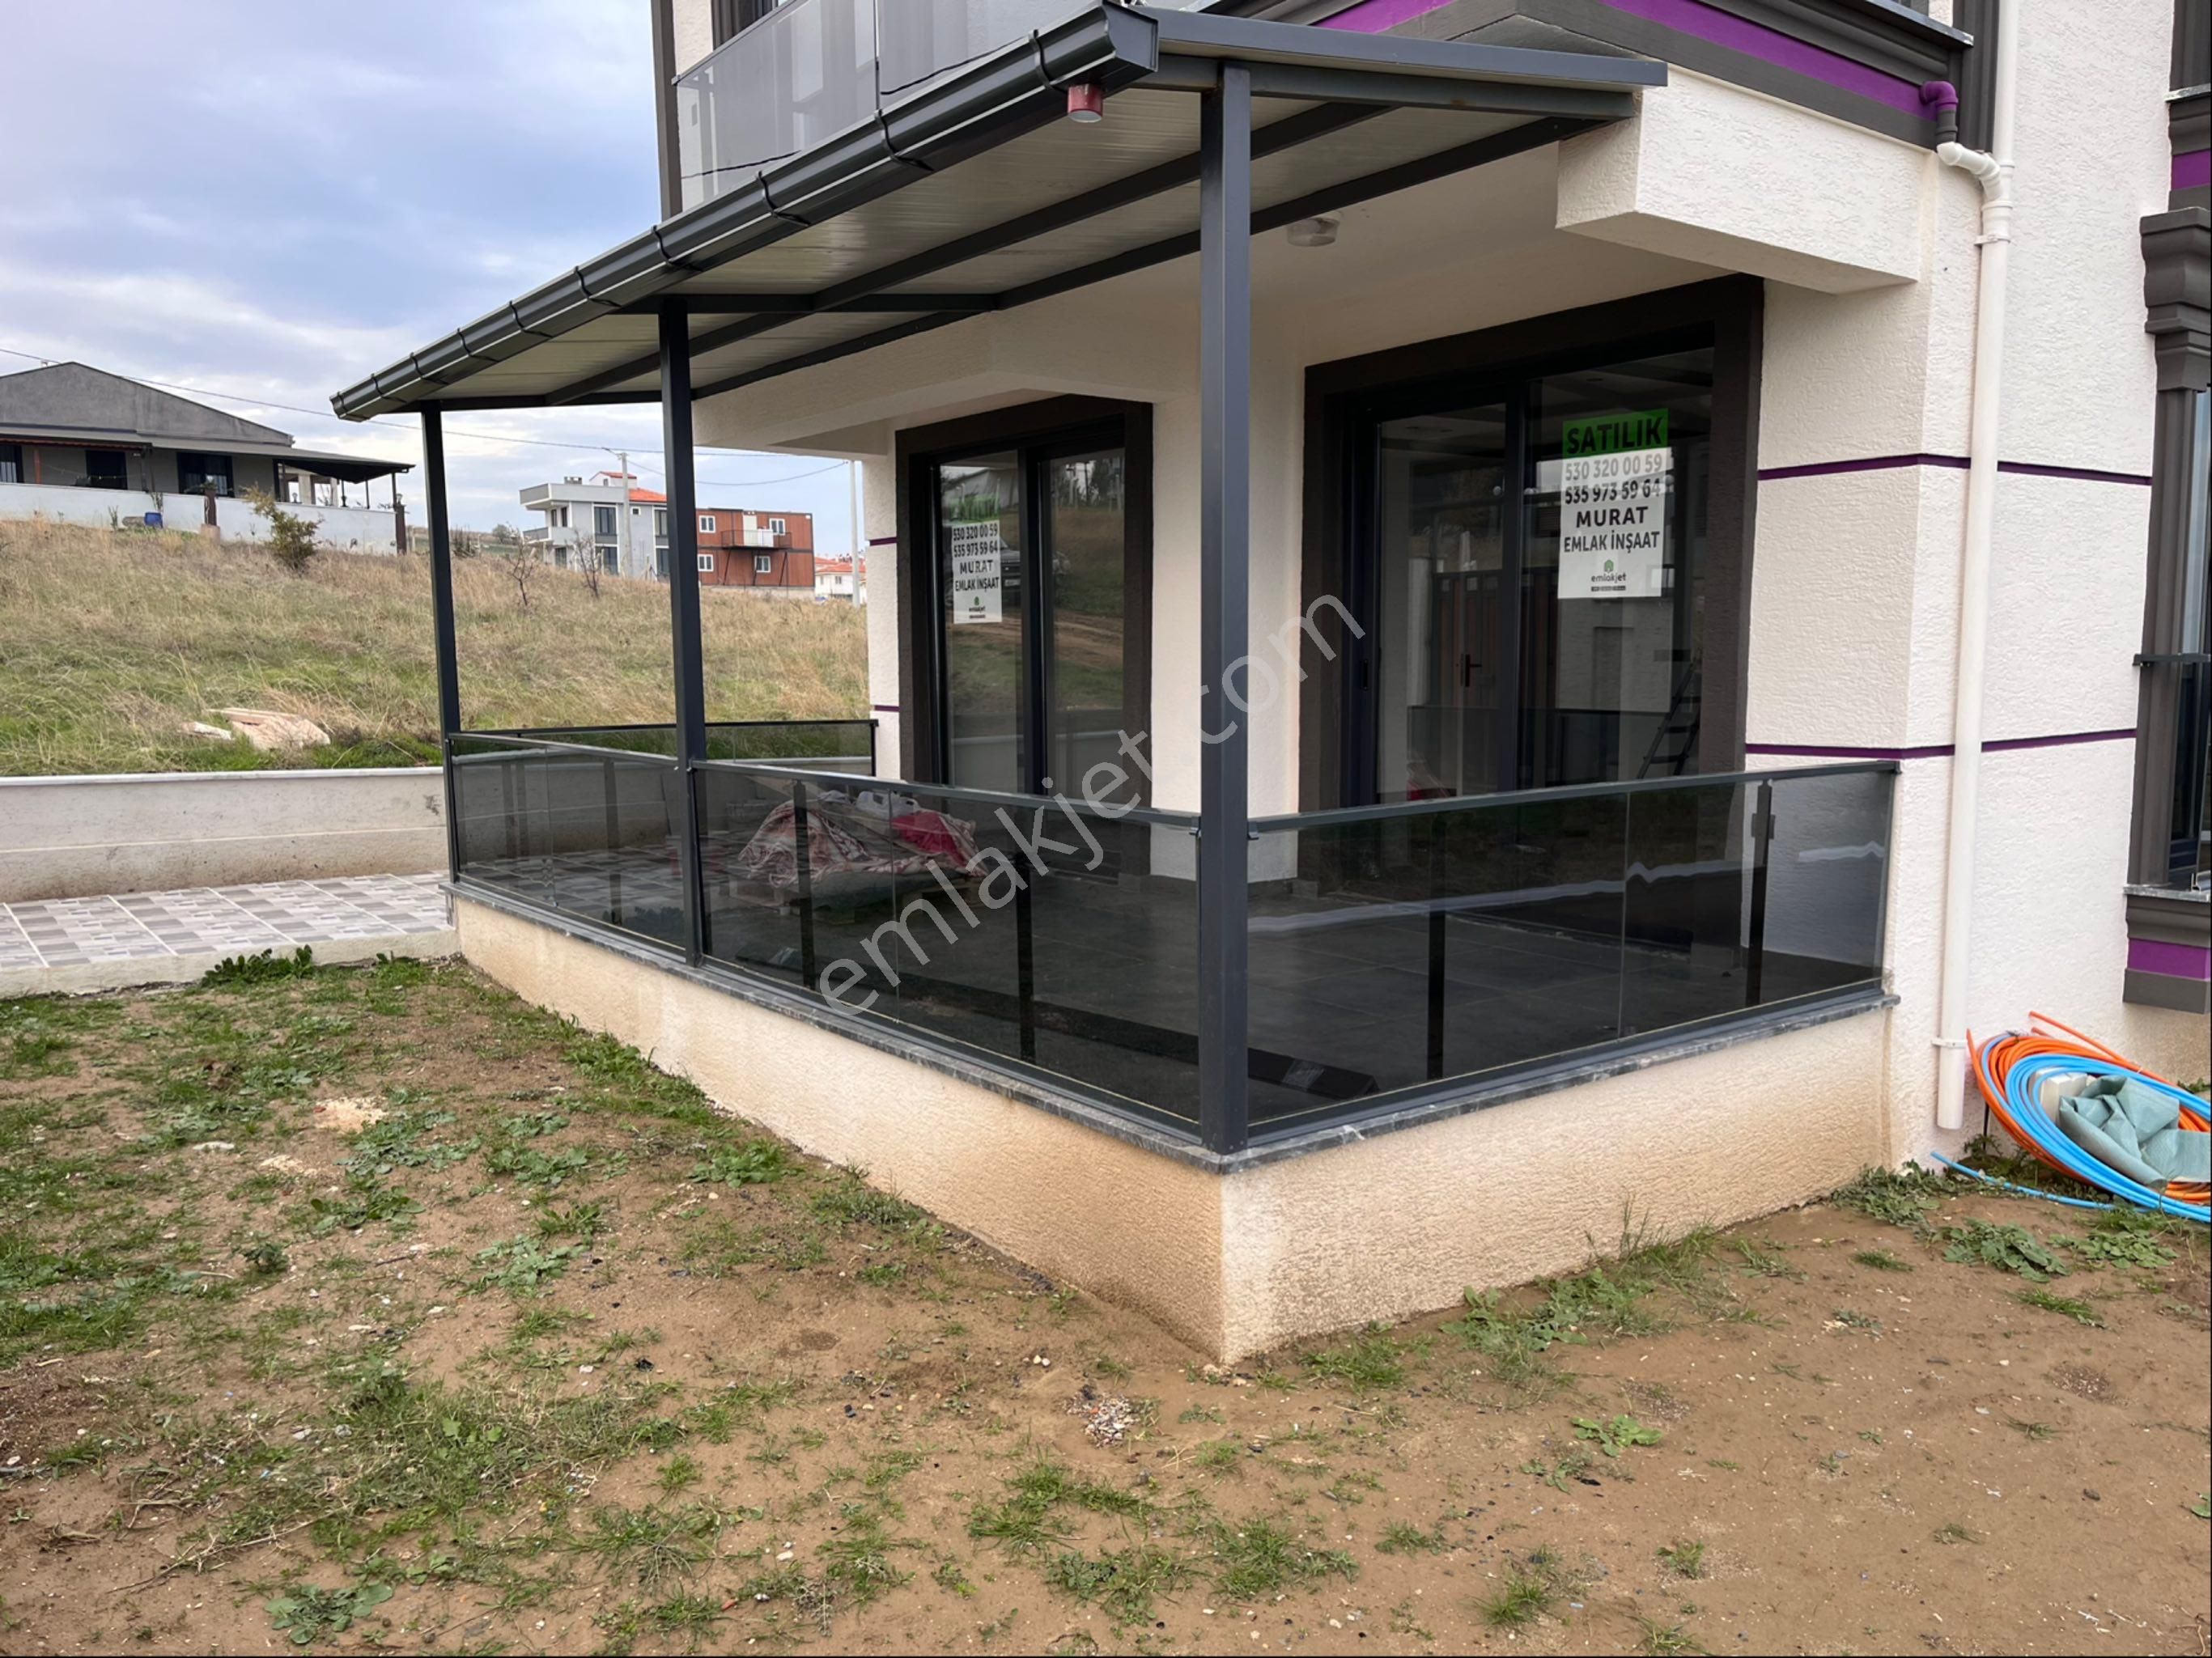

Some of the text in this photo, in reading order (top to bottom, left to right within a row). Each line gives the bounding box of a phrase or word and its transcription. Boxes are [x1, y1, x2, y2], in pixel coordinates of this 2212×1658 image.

[1567, 418, 1663, 455] SATILIK
[1565, 454, 1662, 481] 530 320 00 59
[1565, 478, 1660, 504] 535 973 59 64
[1577, 506, 1648, 528] MURAT
[953, 523, 998, 541] 530 320 00 59
[1564, 531, 1660, 553] EMLAK İNŞAAT
[953, 540, 998, 558] 535 973 59 64
[960, 560, 993, 575] MURAT
[955, 579, 975, 592] EMLAK
